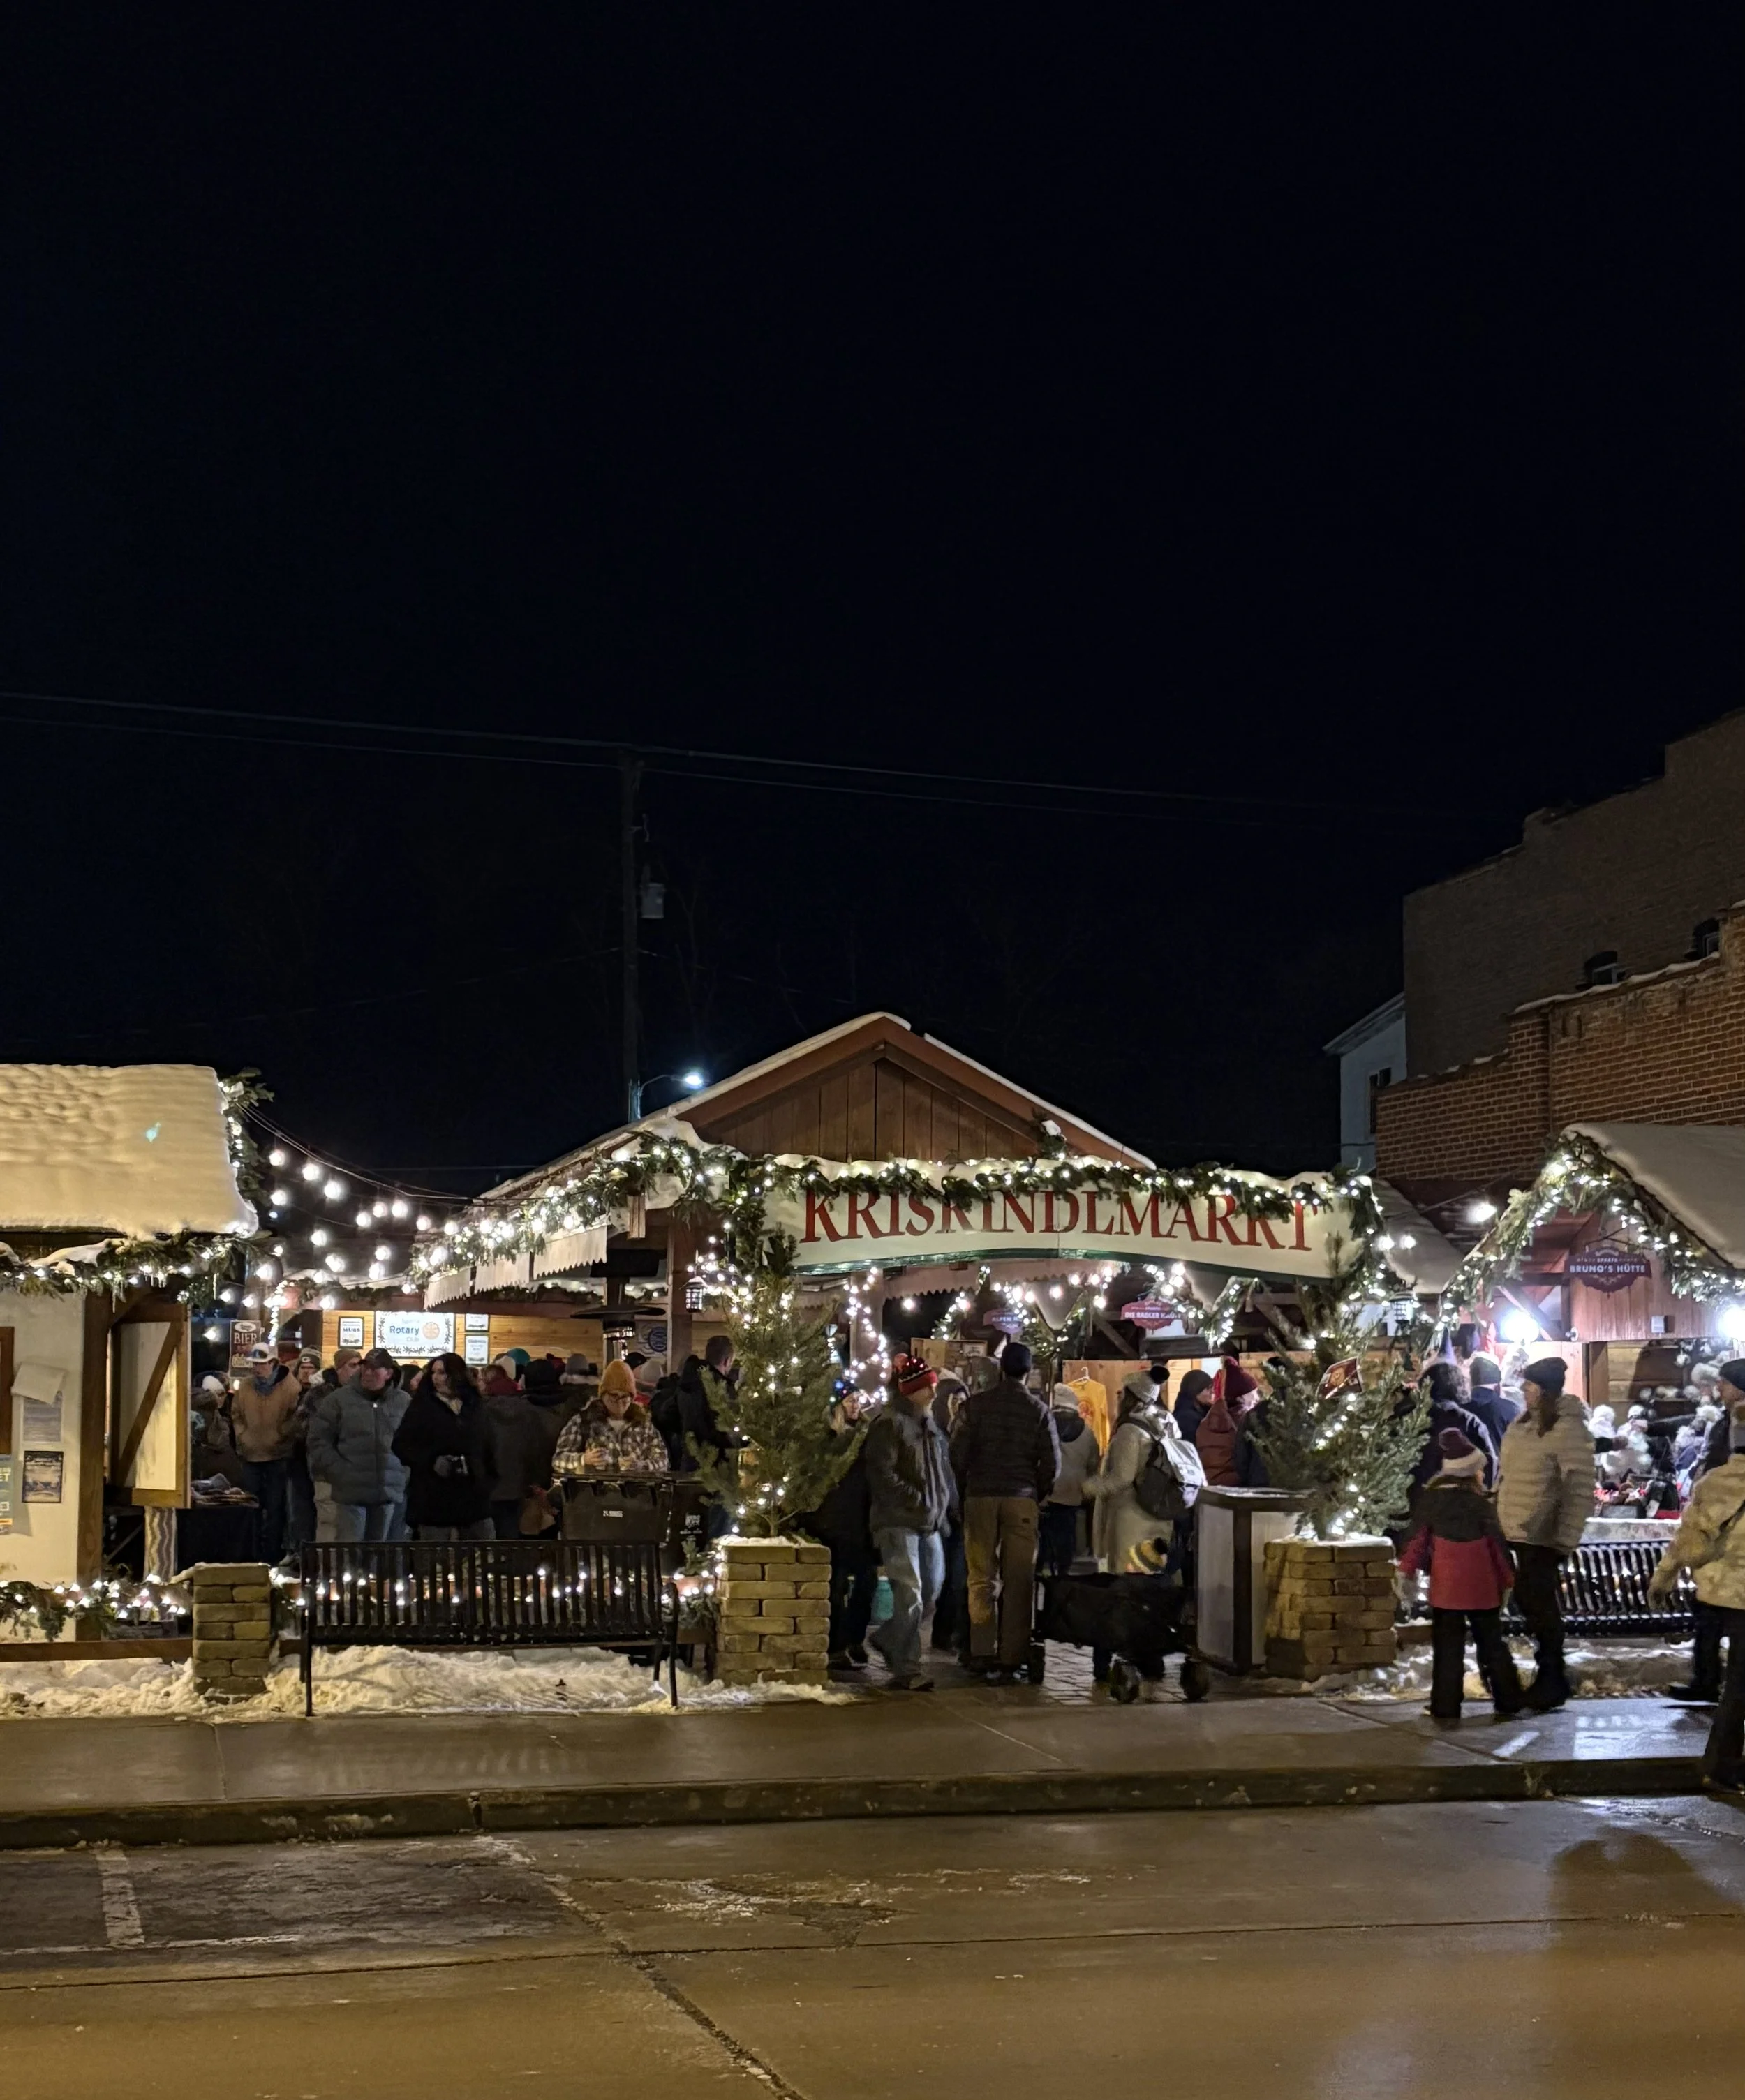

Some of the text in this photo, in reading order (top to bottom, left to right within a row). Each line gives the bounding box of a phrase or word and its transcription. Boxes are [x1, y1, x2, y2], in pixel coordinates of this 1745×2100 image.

[1569, 1263, 1646, 1273] BRUNO'S HÜTTE
[389, 1325, 419, 1335] Rotary
[234, 1332, 257, 1344] BIER
